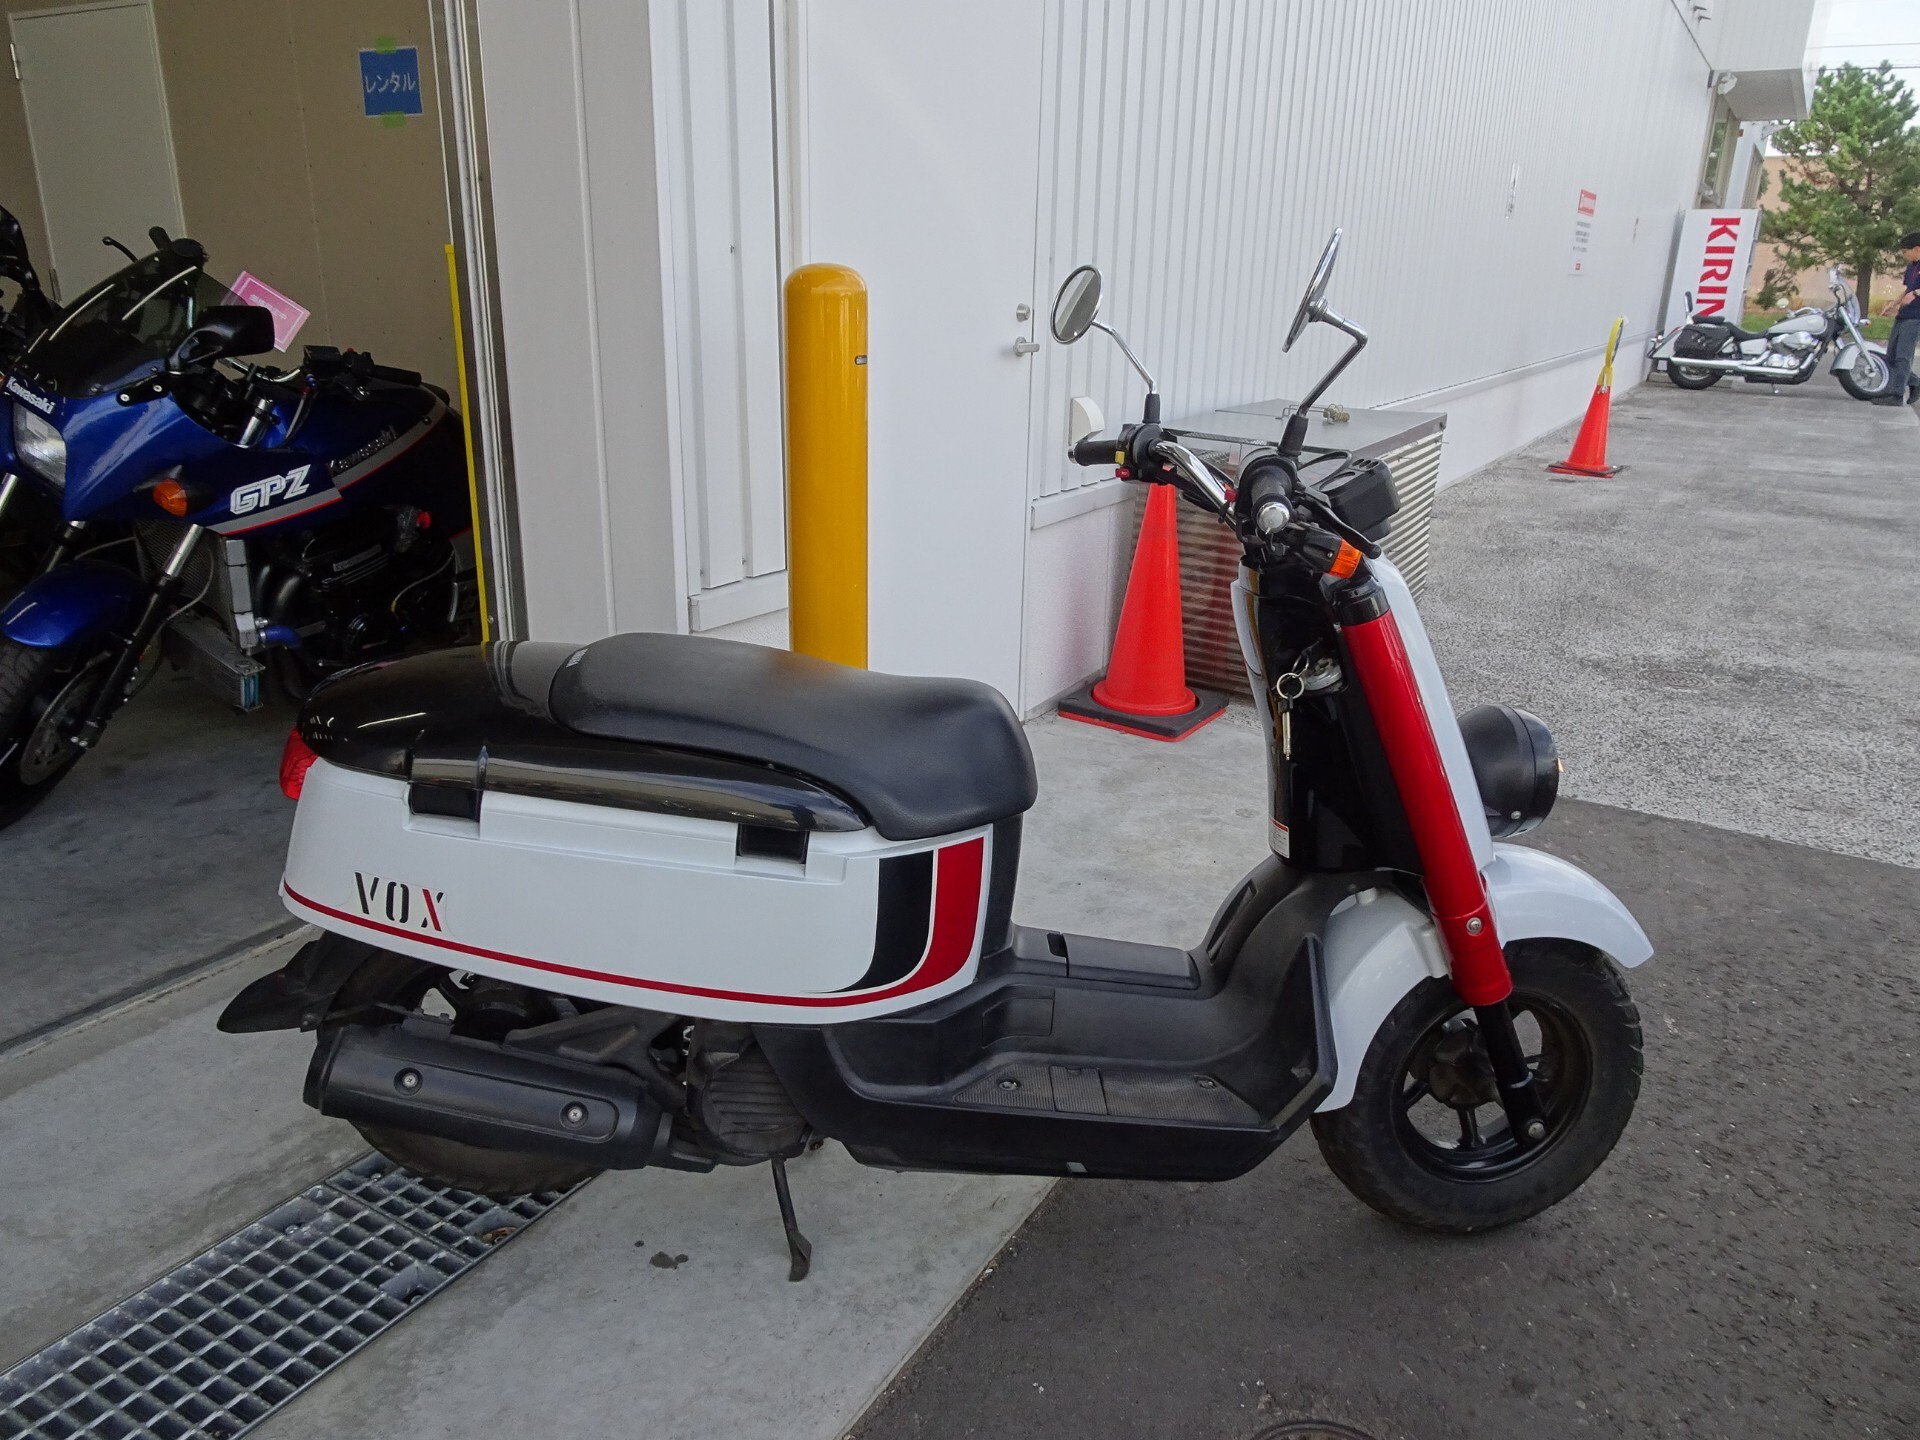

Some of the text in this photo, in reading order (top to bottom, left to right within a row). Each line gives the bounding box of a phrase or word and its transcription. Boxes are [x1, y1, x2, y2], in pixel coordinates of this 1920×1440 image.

[365, 72, 416, 93] レンタル
[1695, 217, 1741, 317] KIRIN
[6, 375, 55, 414] Kawasaki
[230, 463, 312, 515] GPZ
[354, 871, 444, 932] VOX
